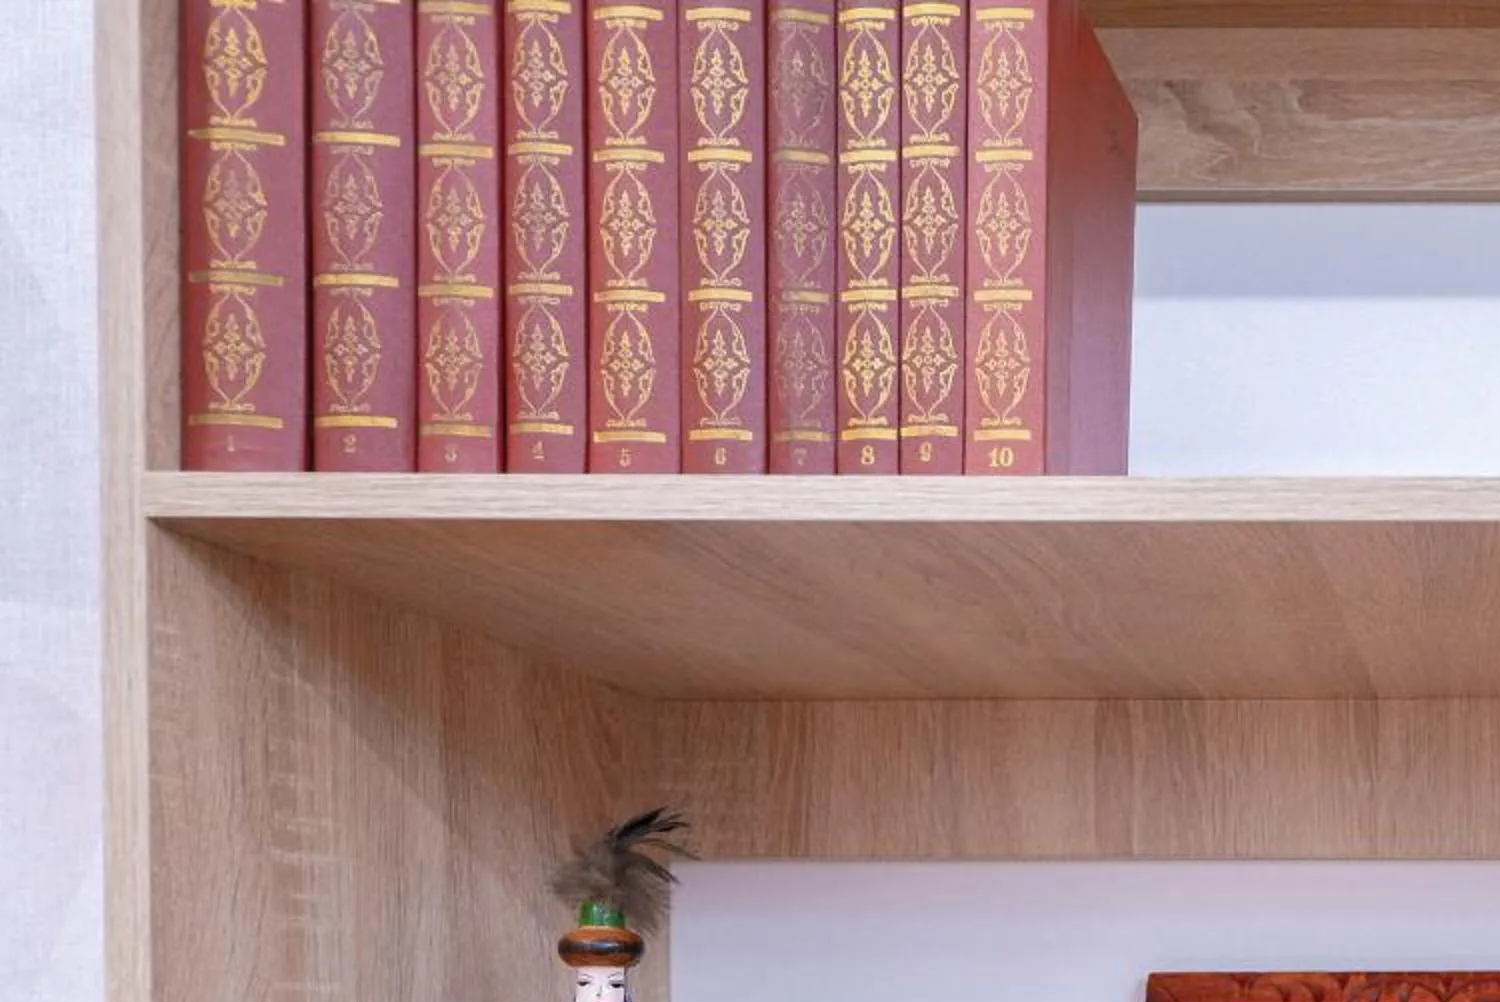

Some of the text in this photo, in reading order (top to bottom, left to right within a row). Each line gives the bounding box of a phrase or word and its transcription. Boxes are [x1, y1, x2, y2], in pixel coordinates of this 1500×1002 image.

[343, 434, 357, 453] 2
[532, 440, 545, 461] 4
[919, 441, 933, 463] 9
[619, 448, 632, 467] 5
[714, 447, 727, 466] 6
[861, 444, 876, 466] 8
[988, 447, 1015, 467] 10
